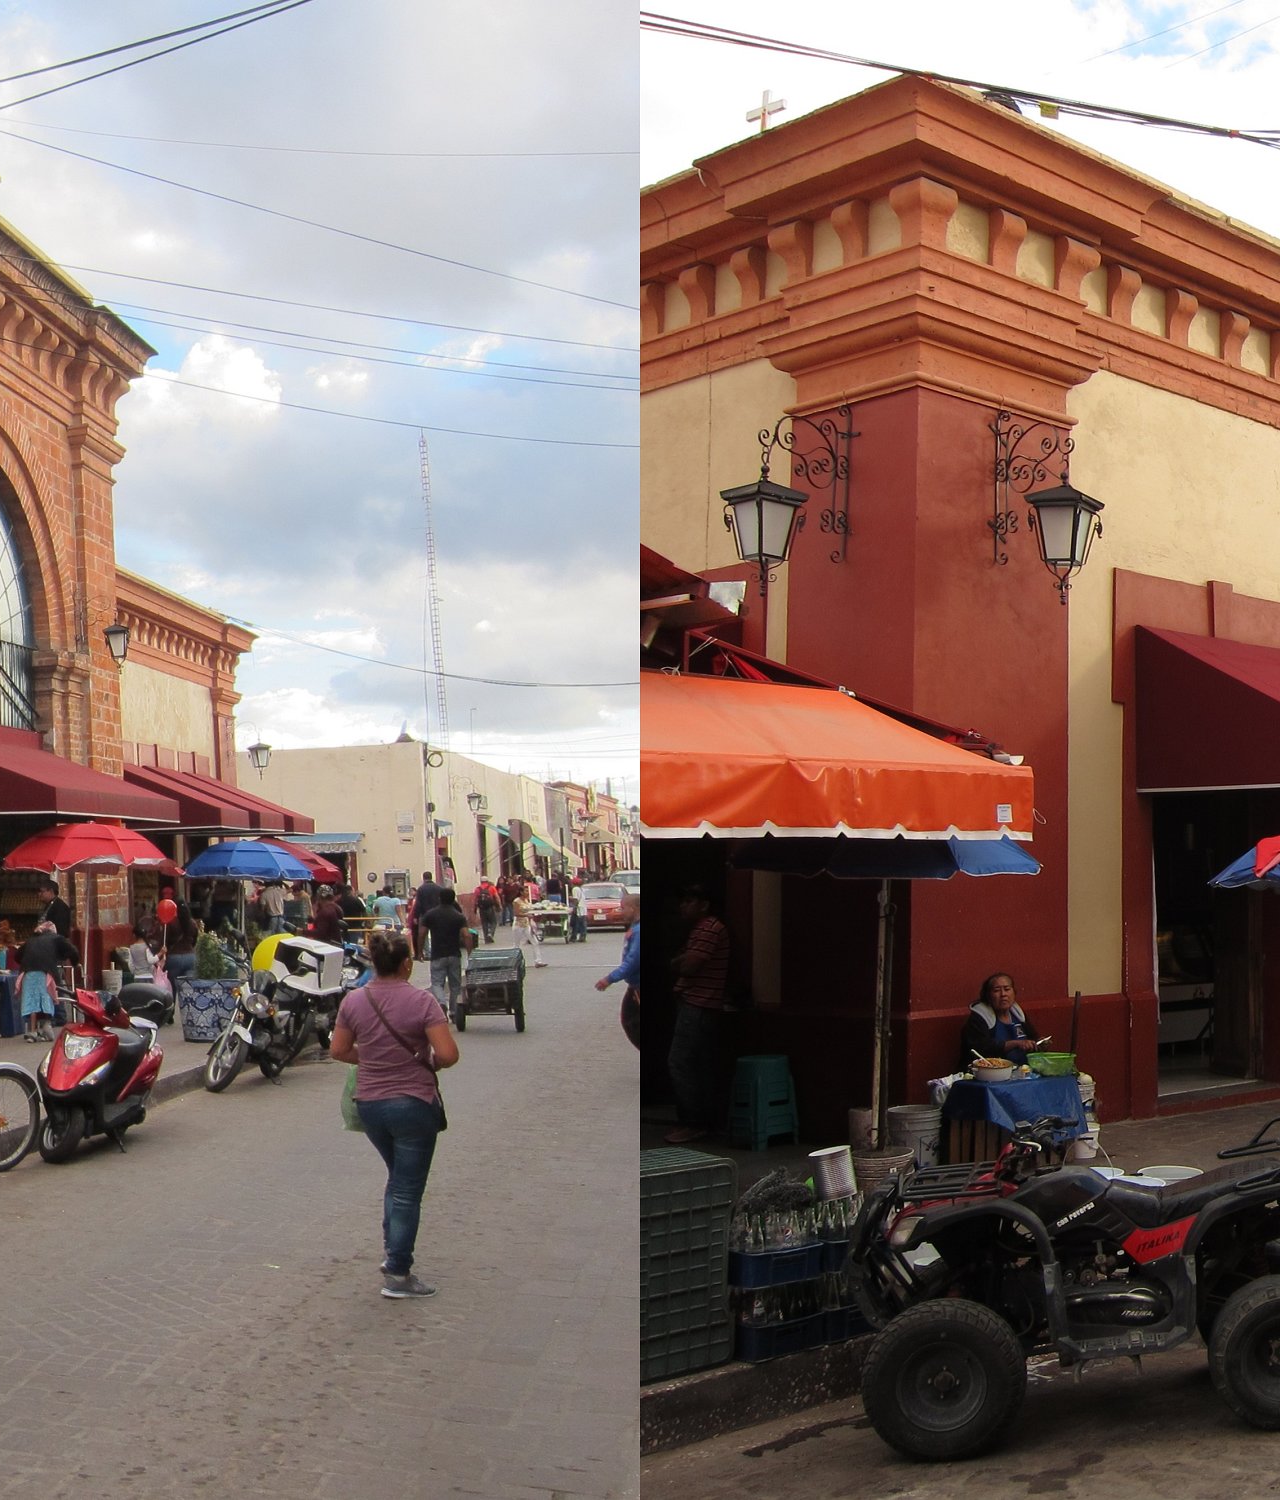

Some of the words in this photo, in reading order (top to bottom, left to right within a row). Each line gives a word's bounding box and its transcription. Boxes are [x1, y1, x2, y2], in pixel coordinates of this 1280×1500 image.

[1056, 1216, 1069, 1227] con
[1069, 1202, 1095, 1220] reversa
[1136, 1231, 1180, 1253] ITALIKA
